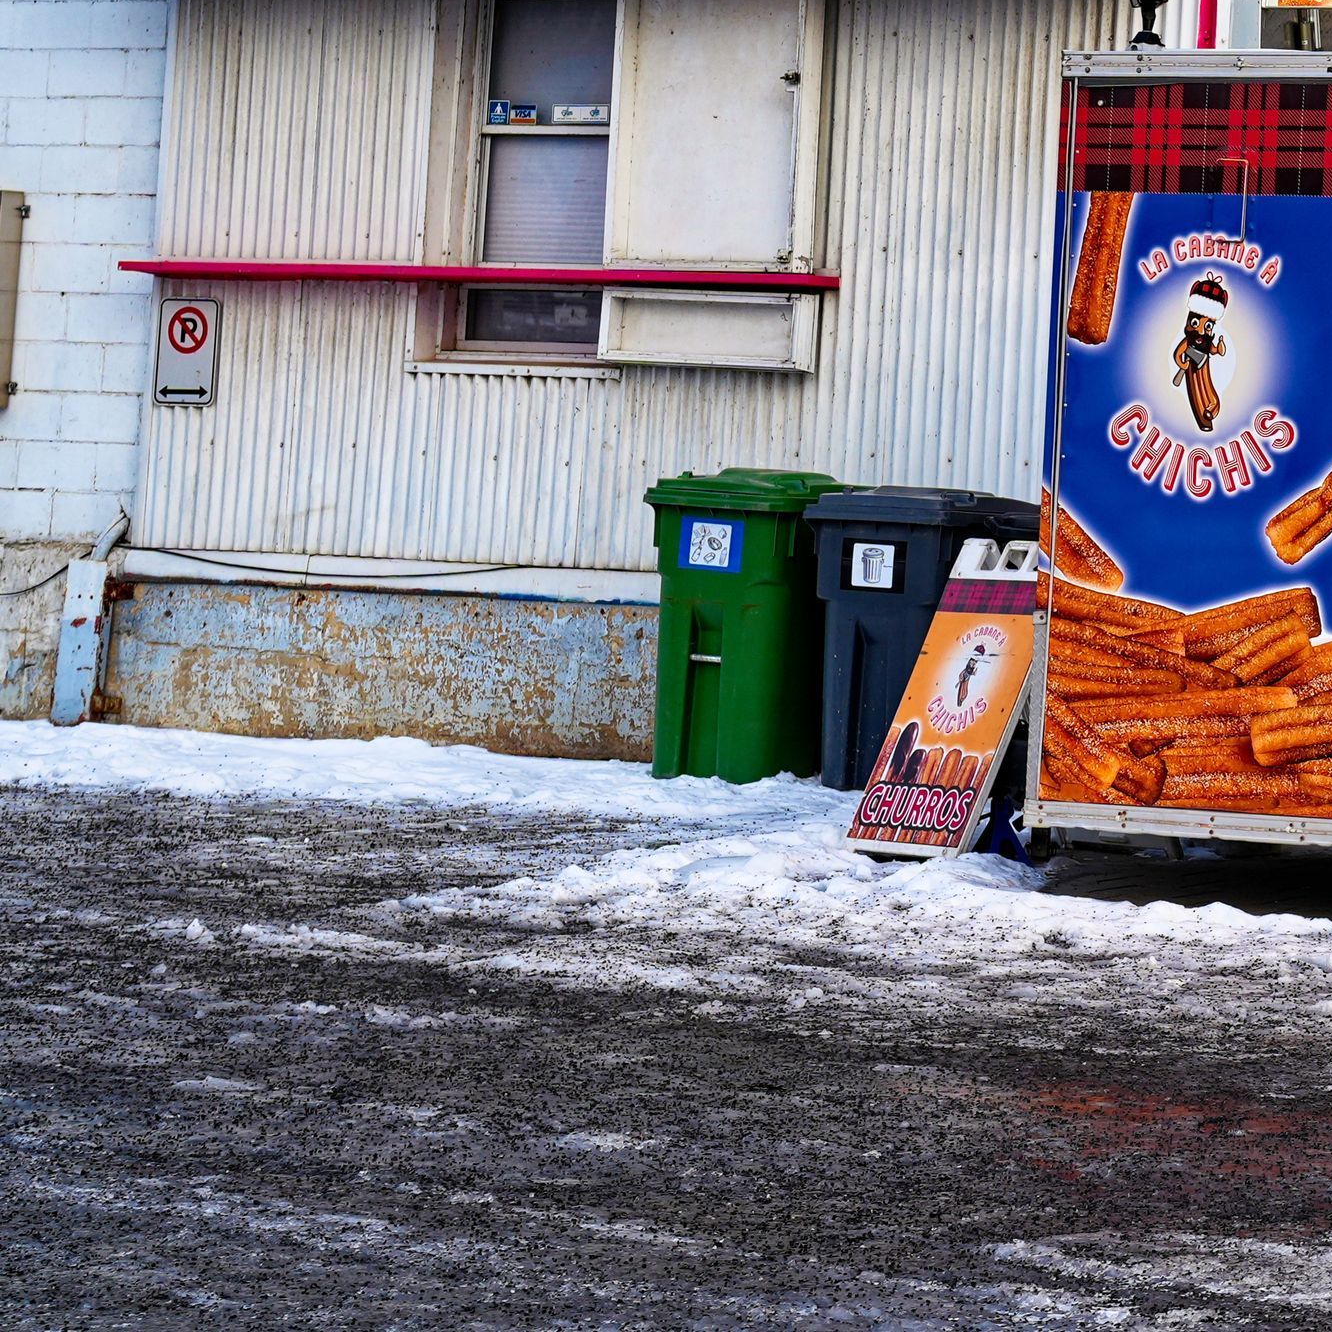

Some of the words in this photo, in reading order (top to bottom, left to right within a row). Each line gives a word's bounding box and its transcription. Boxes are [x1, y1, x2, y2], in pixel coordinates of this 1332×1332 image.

[1141, 250, 1168, 280] LA
[1174, 235, 1259, 268] CABANE
[1111, 404, 1295, 497] CHICHIS
[962, 633, 971, 645] LA
[928, 695, 987, 734] CHICHIS
[861, 783, 975, 829] CHURROS
